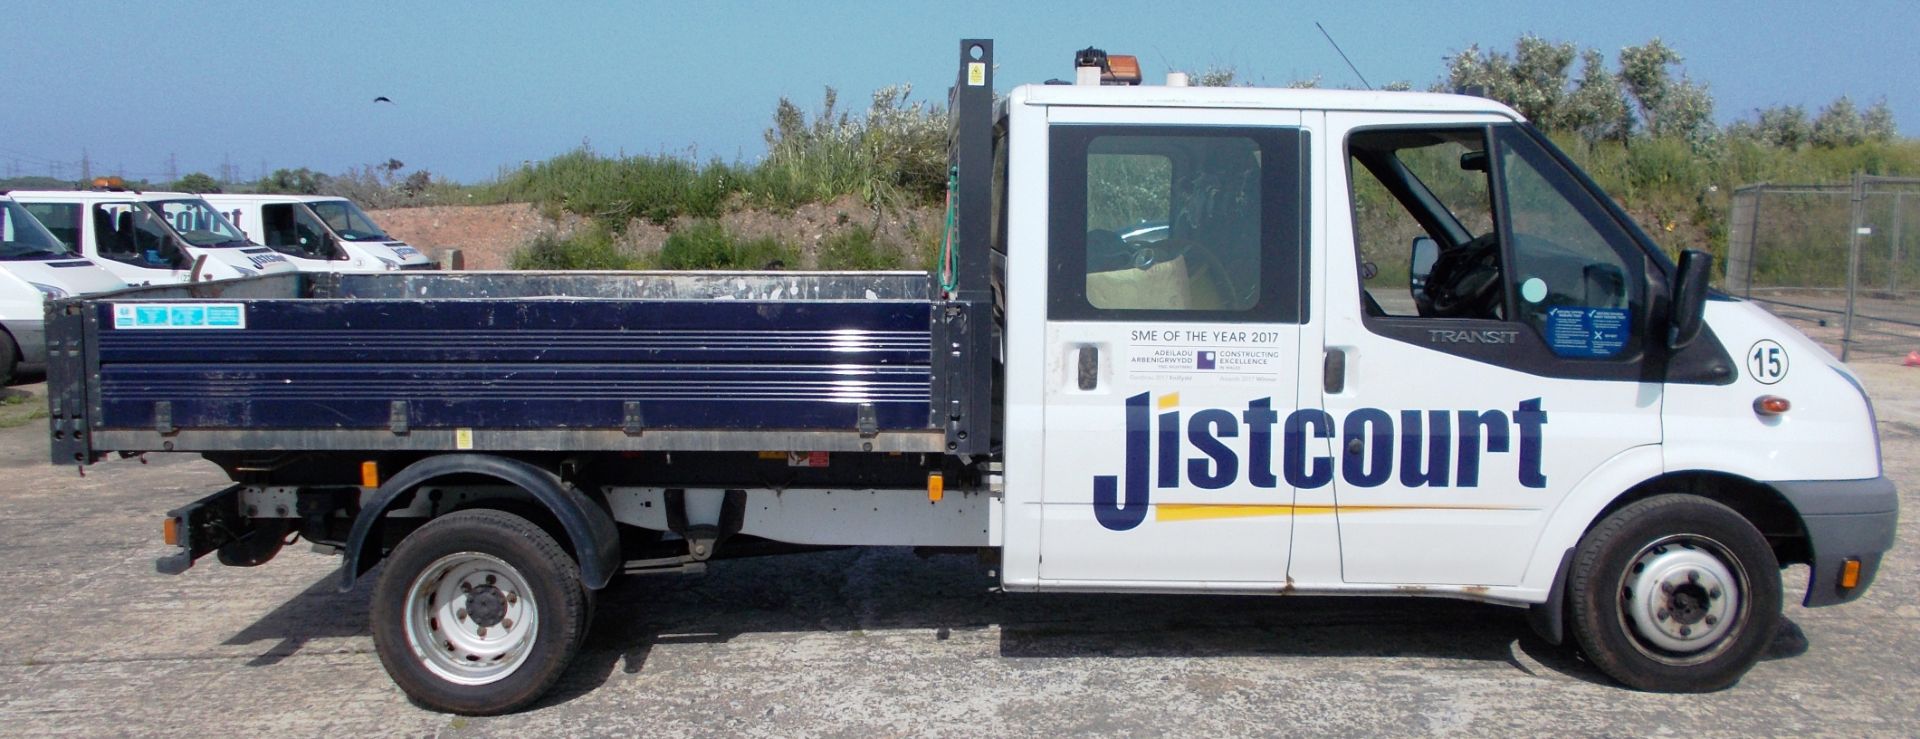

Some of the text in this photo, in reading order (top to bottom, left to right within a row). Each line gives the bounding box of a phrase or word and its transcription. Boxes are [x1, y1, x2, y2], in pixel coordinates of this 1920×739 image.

[1131, 330, 1279, 343] SME OF THE YEAR 2017
[1428, 329, 1519, 344] TRANSIT
[1219, 350, 1279, 358] CONSTRUCTING
[1754, 347, 1781, 377] 15
[1093, 391, 1548, 531] Jistcourt
